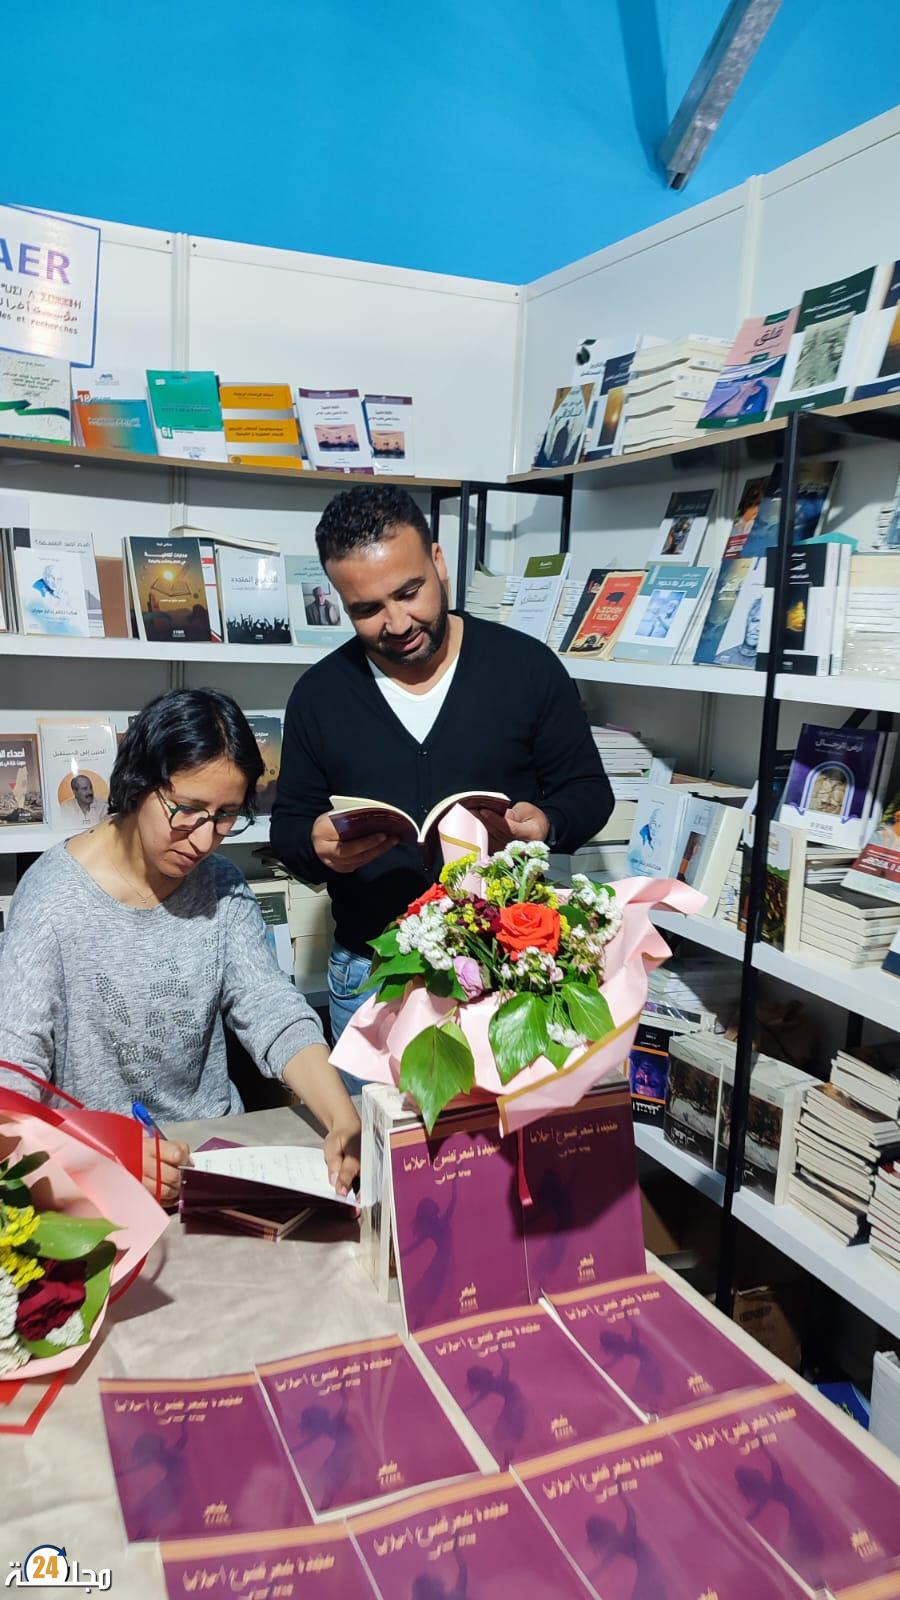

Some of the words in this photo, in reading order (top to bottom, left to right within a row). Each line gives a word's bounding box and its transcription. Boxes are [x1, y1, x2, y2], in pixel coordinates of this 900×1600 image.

[16, 315, 25, 324] et
[31, 319, 78, 335] recherches
[753, 326, 785, 347] قلق
